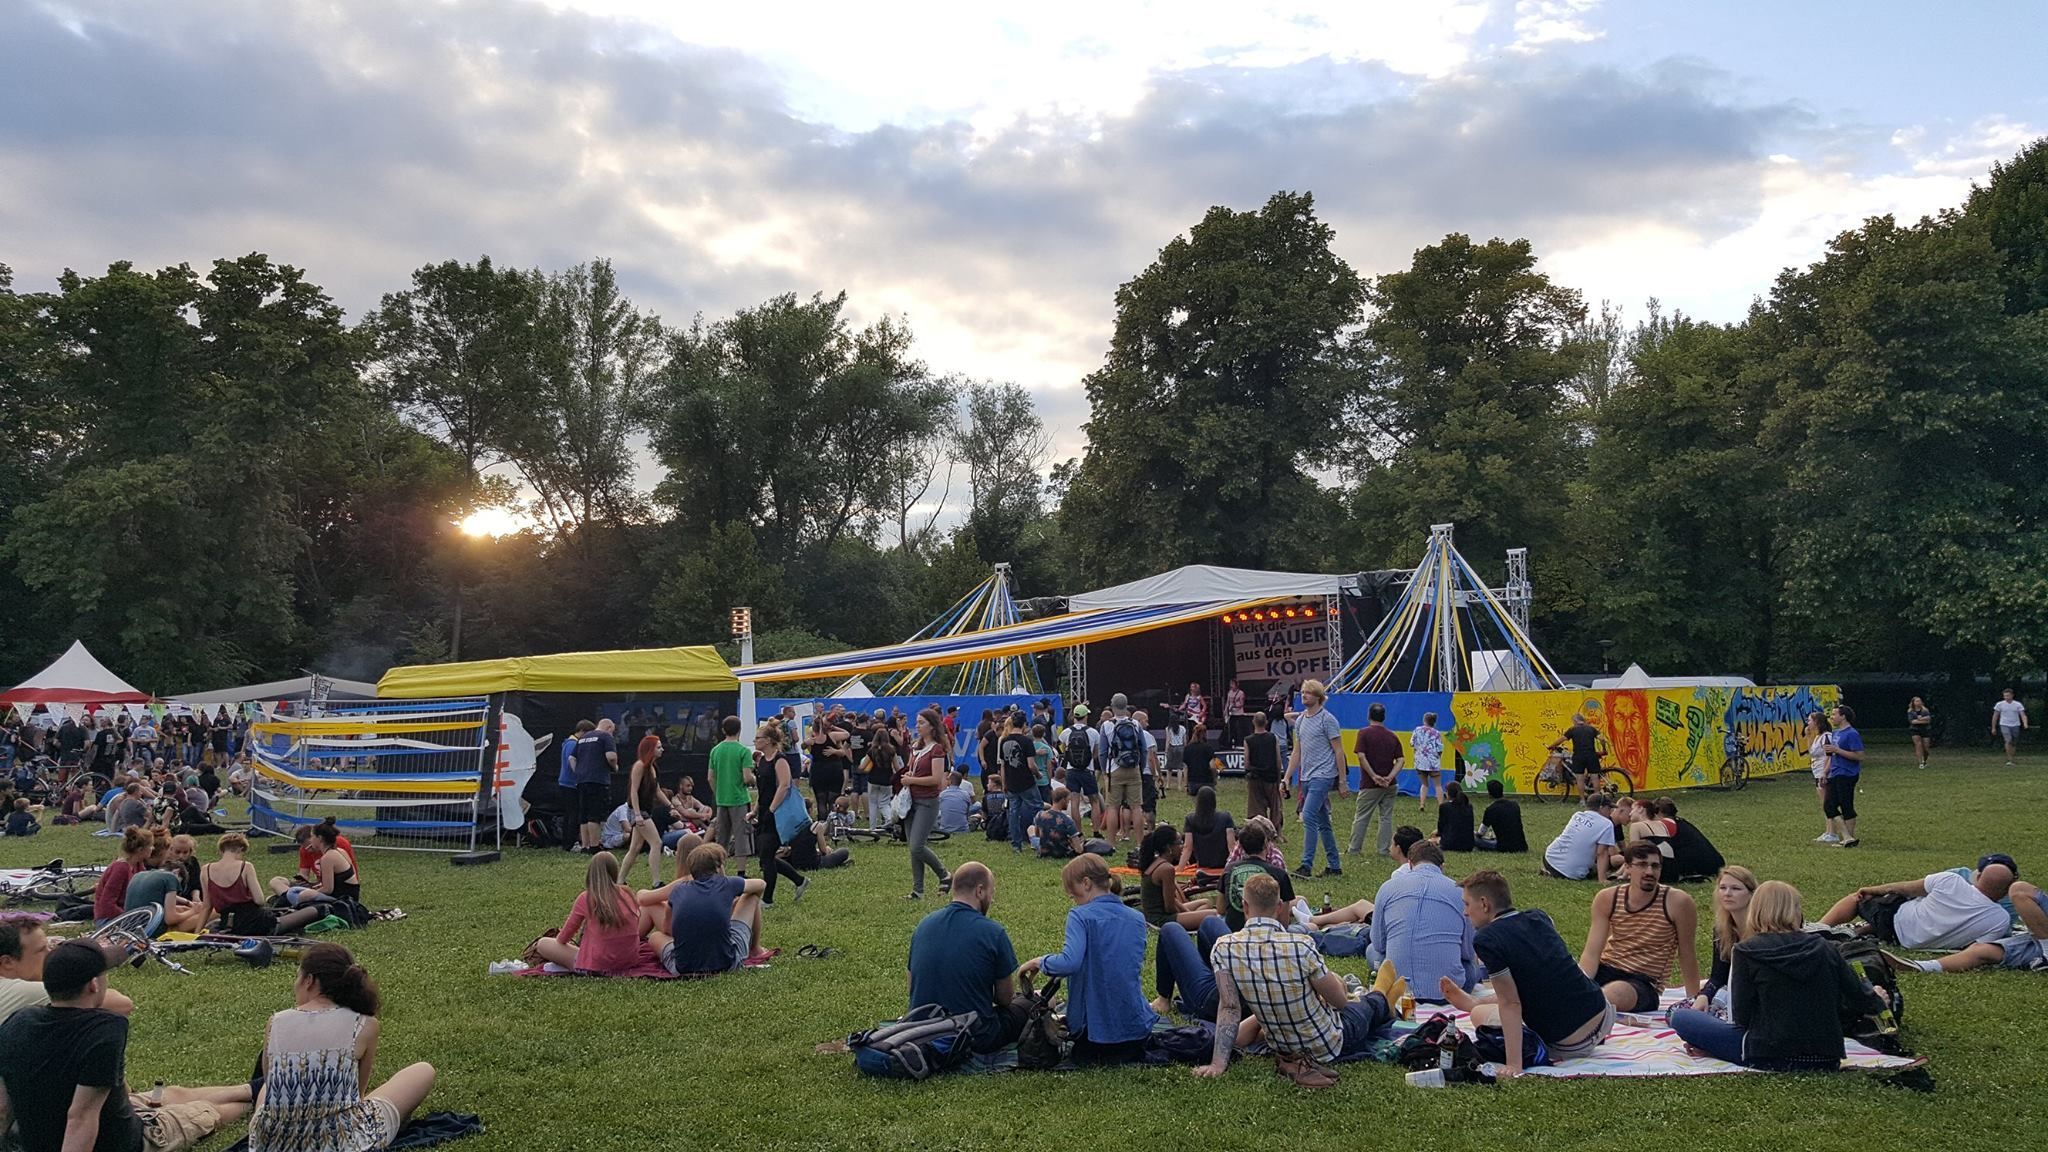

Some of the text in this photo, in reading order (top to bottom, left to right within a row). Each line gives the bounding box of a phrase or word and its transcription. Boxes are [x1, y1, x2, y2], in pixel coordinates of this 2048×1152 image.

[1233, 621, 1287, 634] kickt die
[1254, 626, 1327, 647] MAUER
[1237, 647, 1292, 662] aus den
[1267, 656, 1334, 676] KÖPFE
